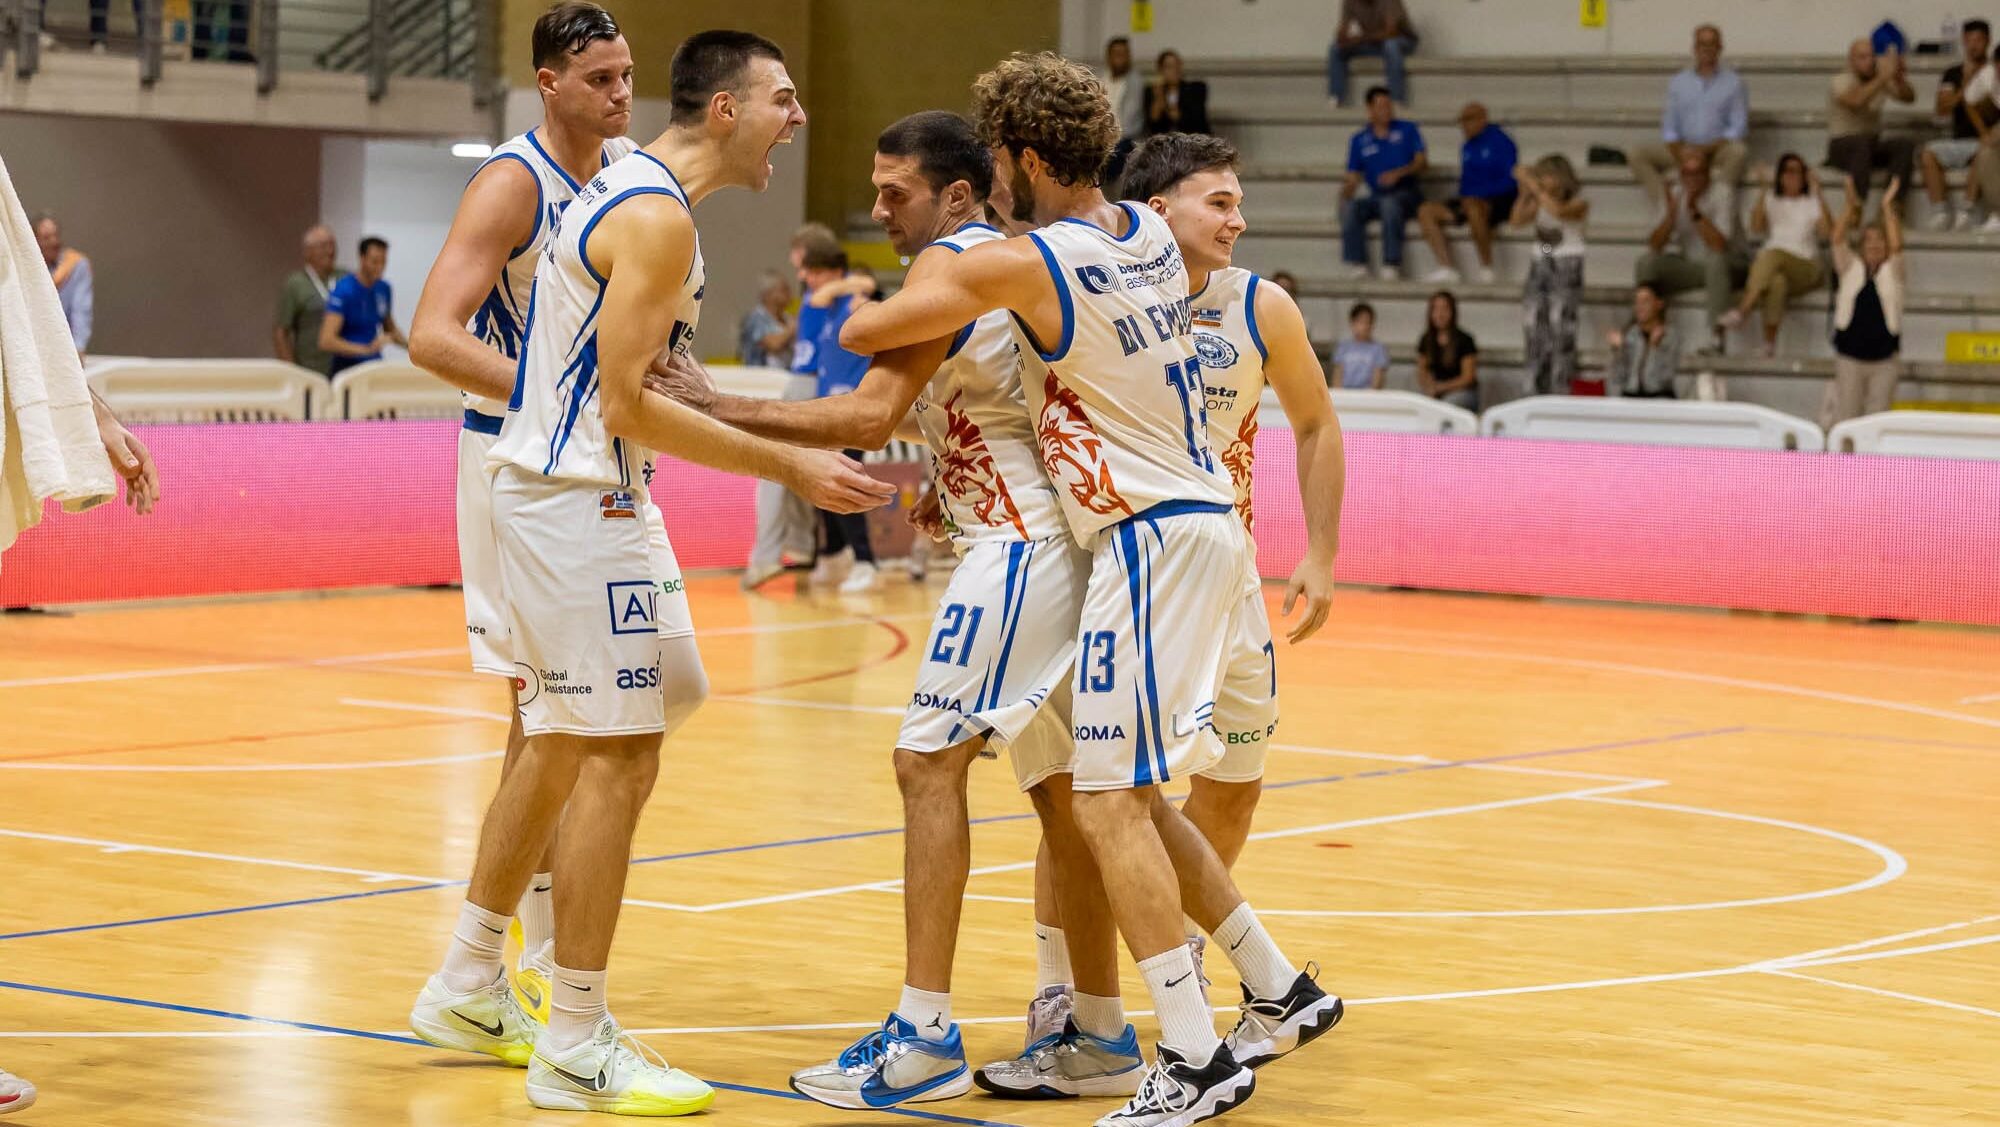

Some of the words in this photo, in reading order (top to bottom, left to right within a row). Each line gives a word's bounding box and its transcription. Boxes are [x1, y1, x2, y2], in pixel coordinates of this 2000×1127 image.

[1113, 314, 1148, 357] DI
[930, 603, 985, 668] 21
[1078, 630, 1118, 694] 13
[913, 692, 963, 715] ROMA
[1075, 724, 1126, 741] ROMA
[1227, 729, 1261, 744] BCC
